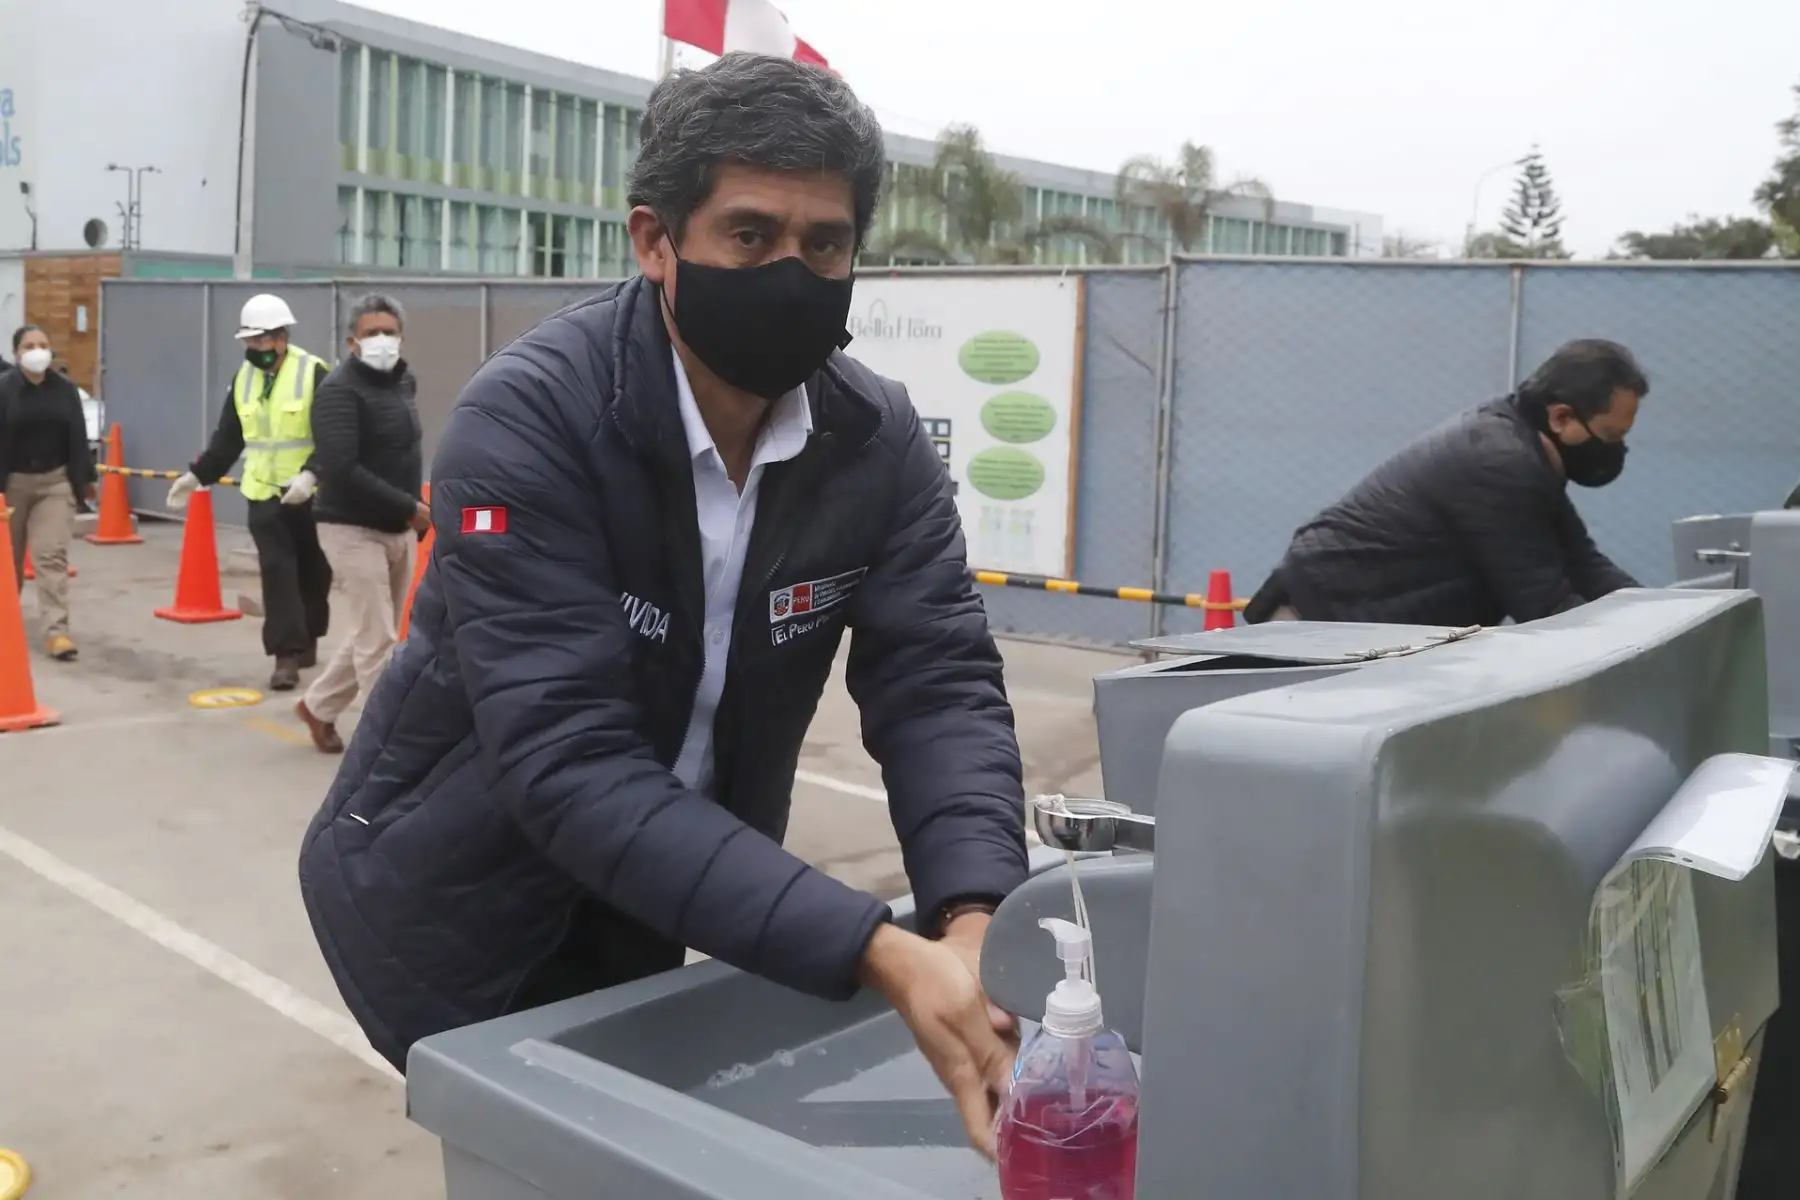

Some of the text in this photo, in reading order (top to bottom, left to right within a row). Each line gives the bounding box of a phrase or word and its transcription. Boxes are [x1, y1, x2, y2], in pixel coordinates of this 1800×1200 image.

[0, 88, 15, 118] a
[0, 121, 21, 166] ls
[850, 316, 893, 339] Bella
